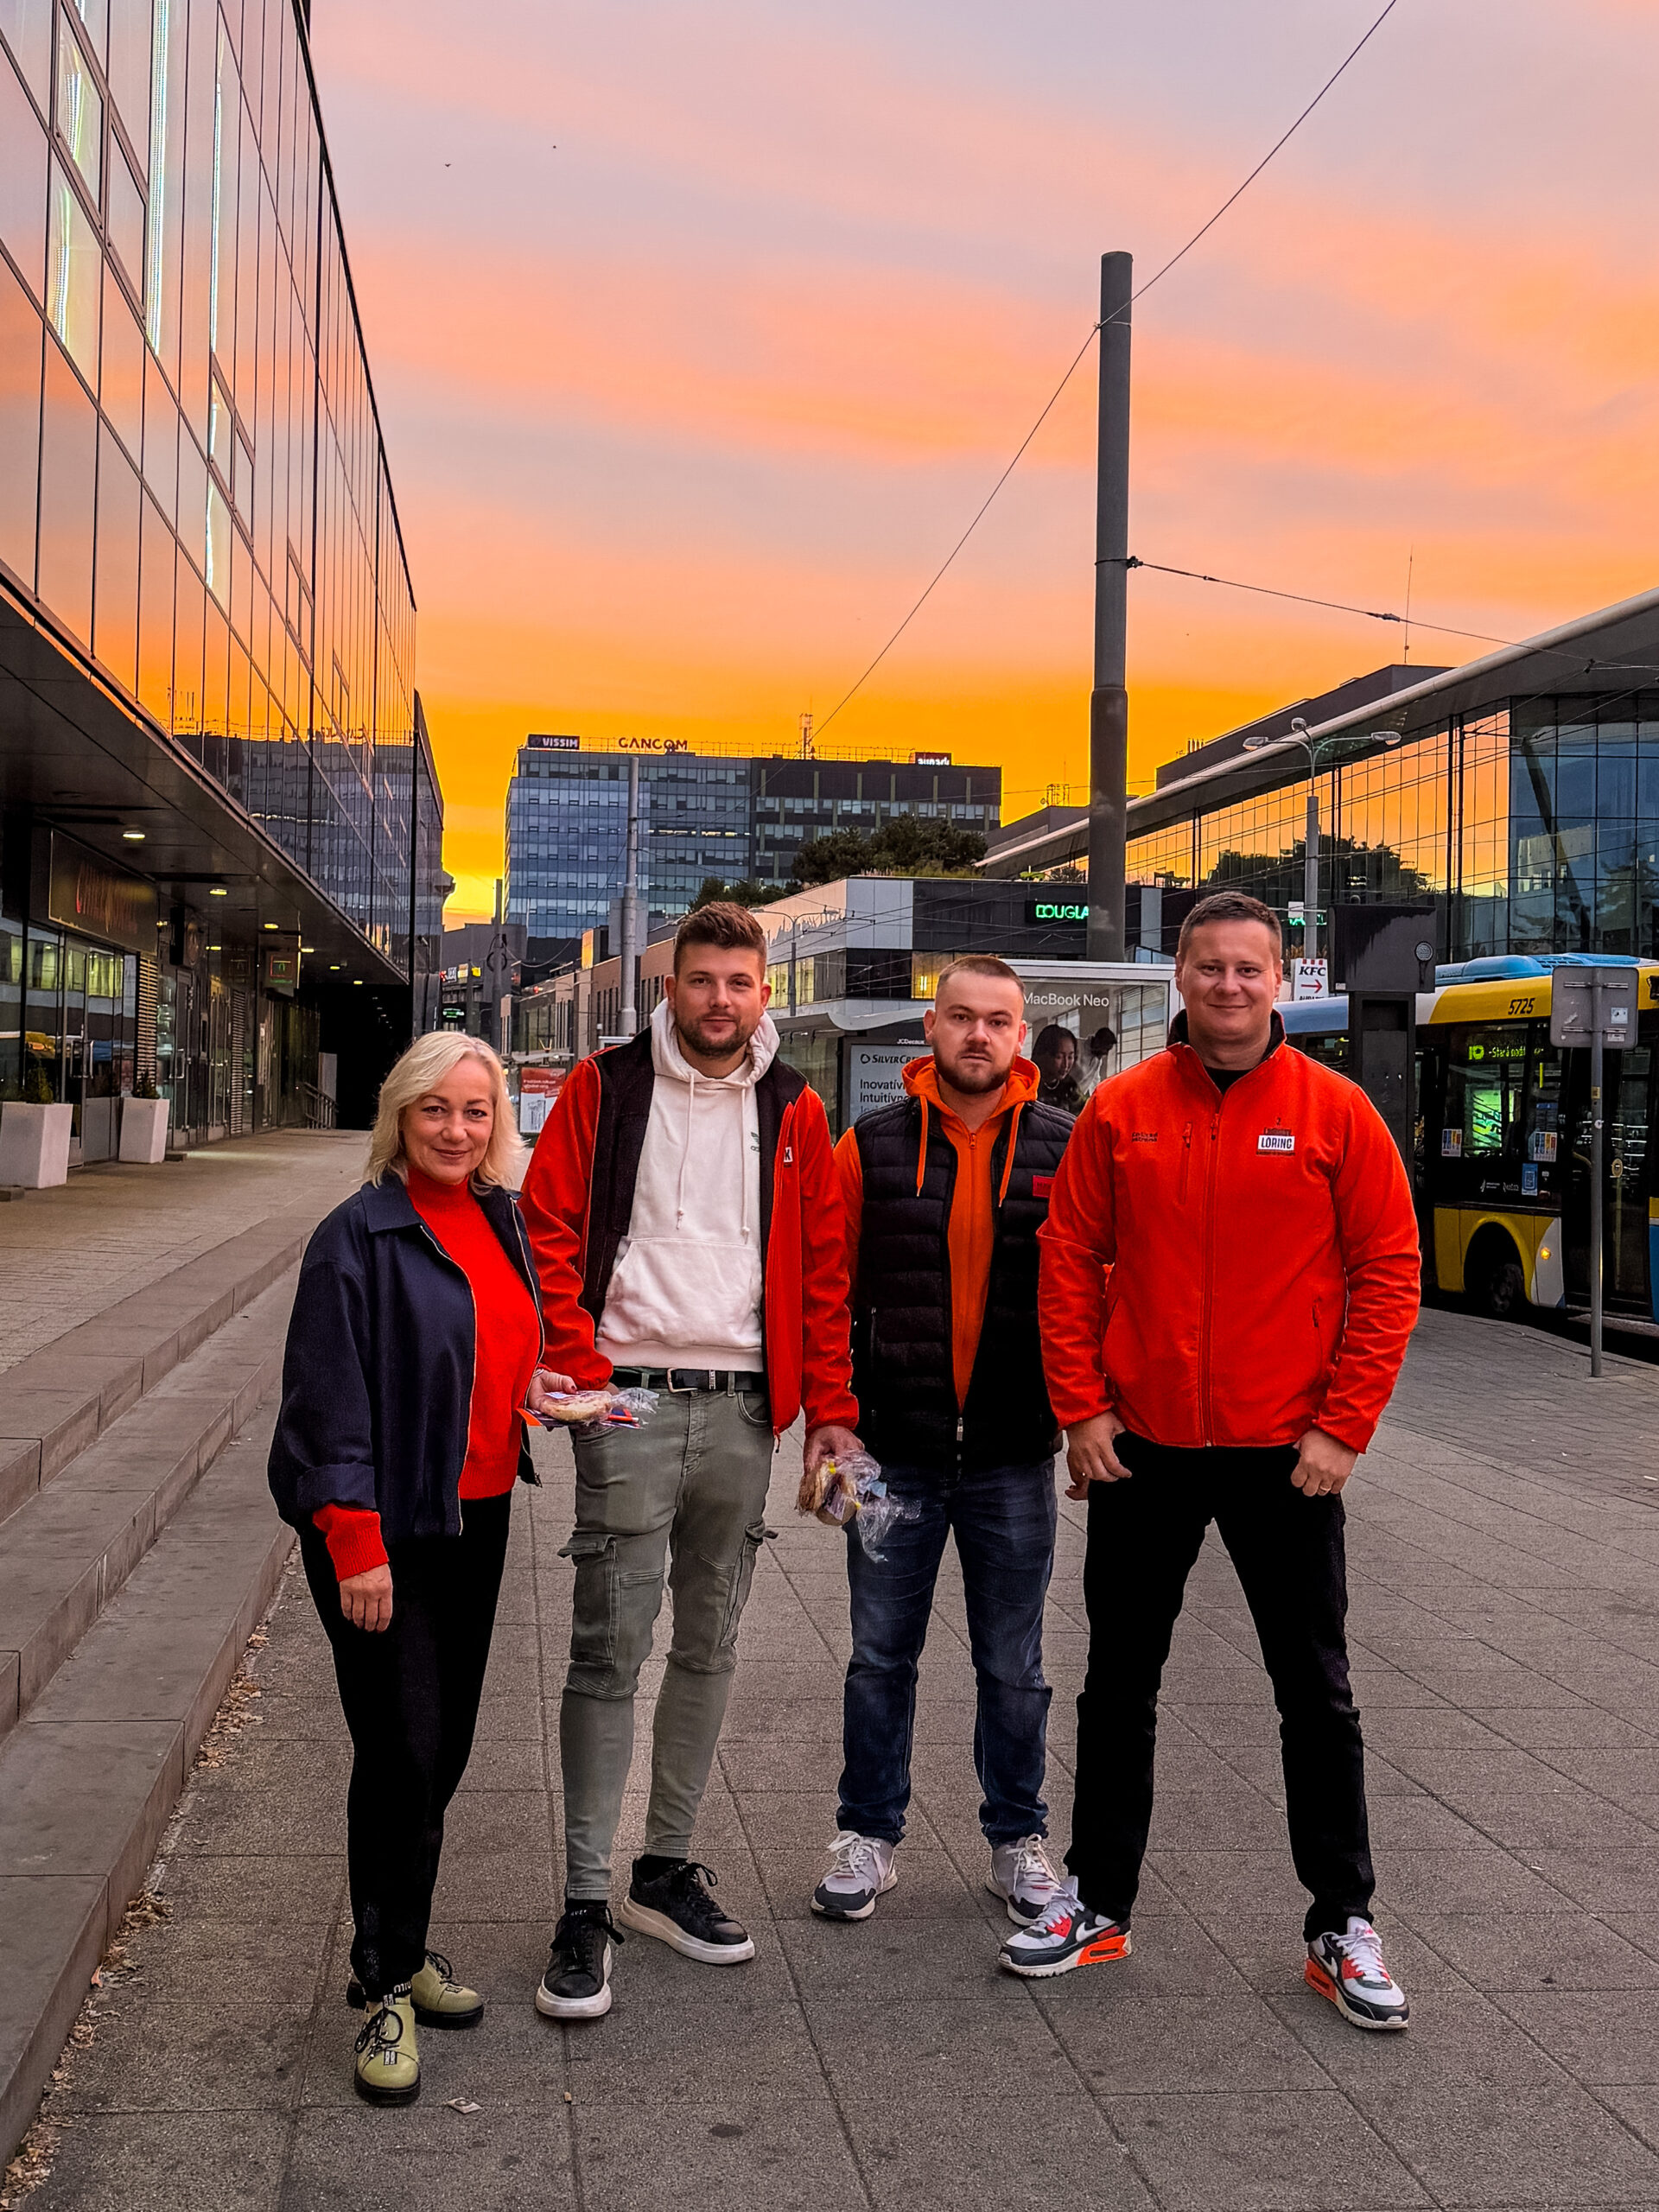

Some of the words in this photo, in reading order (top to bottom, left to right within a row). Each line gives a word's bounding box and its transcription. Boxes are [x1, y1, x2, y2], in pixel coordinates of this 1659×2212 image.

[543, 737, 578, 748] VISSIM
[618, 737, 688, 751] CANCOM
[1299, 966, 1326, 976] KFC
[1024, 993, 1081, 1006] MacBook
[1083, 995, 1109, 1007] Neo
[1508, 998, 1535, 1015] 5725
[860, 1079, 906, 1090] Inovatív
